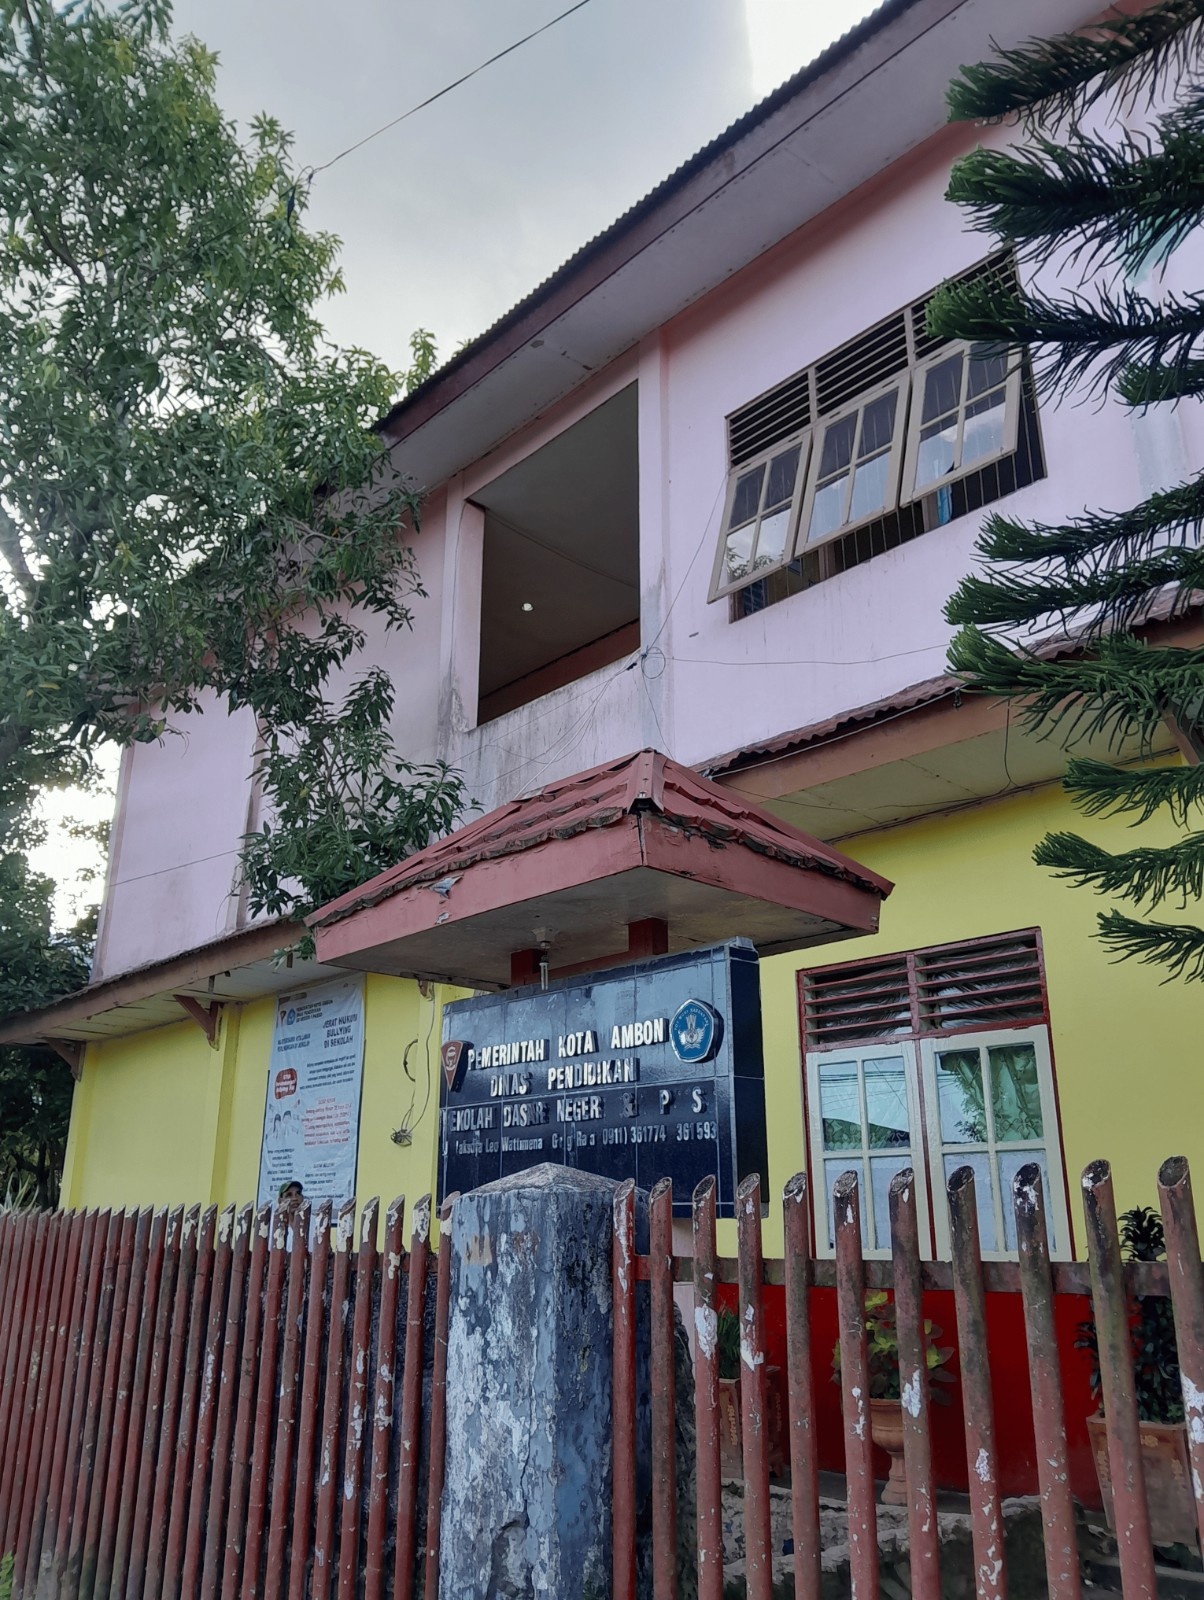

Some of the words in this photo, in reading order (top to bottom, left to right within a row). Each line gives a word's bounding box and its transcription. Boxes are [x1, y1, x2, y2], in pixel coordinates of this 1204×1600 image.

[323, 1040, 330, 1049] DI
[330, 1035, 354, 1048] SEKOLAH
[326, 1025, 352, 1038] BULLYING
[467, 1038, 545, 1071] PEMERINTAH
[558, 1030, 594, 1058] KOTA
[610, 1017, 664, 1049] AMBON
[490, 1072, 528, 1097] DINAS
[547, 1057, 635, 1090] PENDIDIKAN
